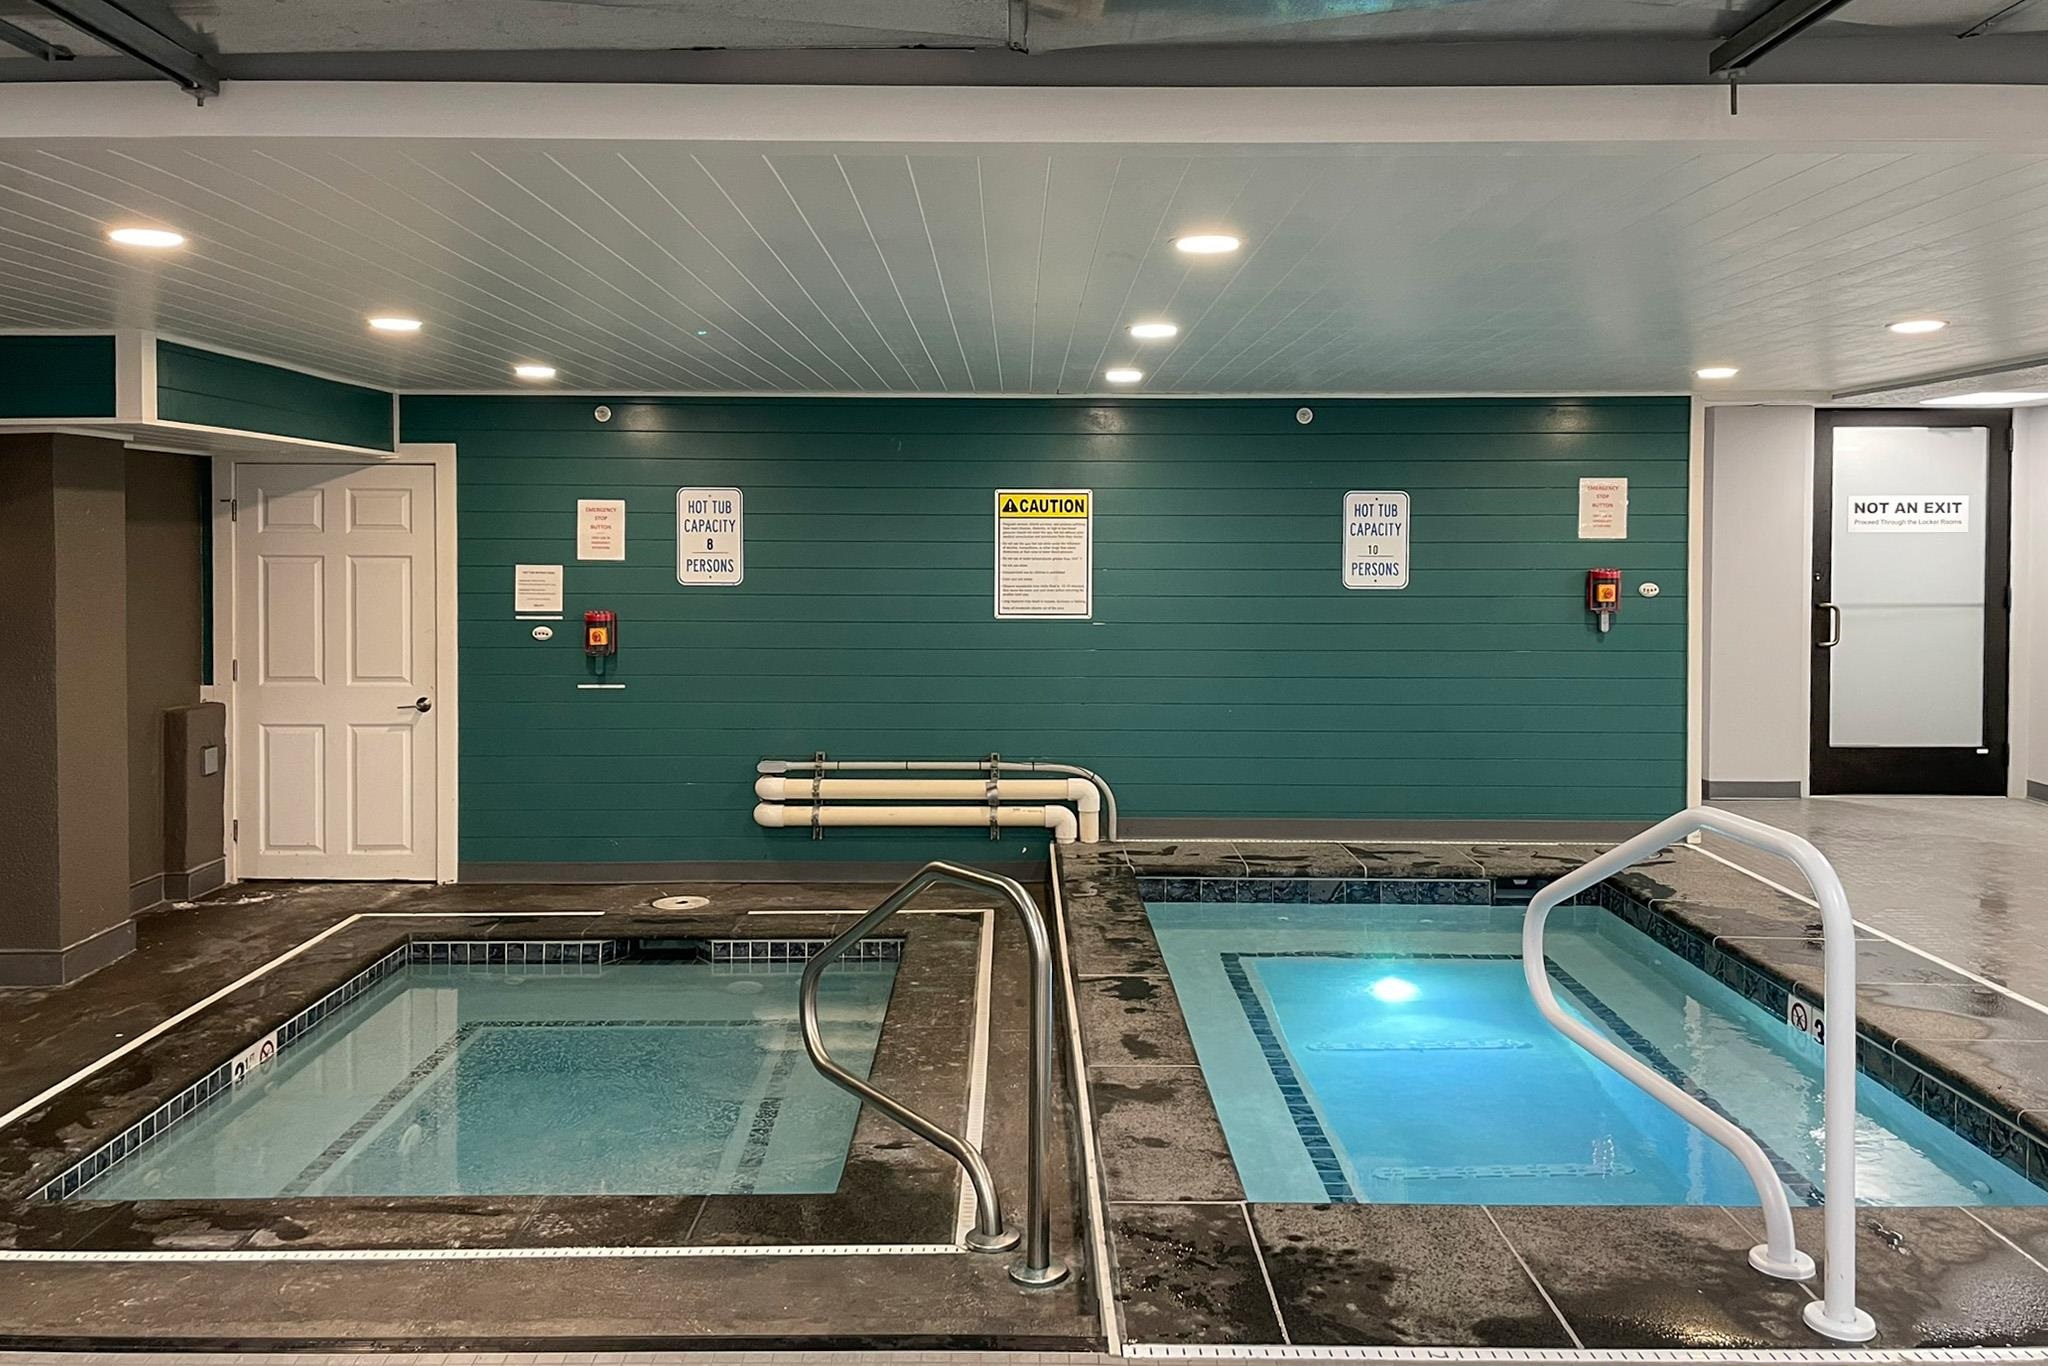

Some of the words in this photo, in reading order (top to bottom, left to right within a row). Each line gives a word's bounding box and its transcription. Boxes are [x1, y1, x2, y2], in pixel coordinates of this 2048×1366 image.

[688, 500, 707, 514] HOT
[712, 500, 732, 514] TUB
[1020, 499, 1084, 513] CAUTION
[1354, 503, 1374, 517] HOT
[1378, 503, 1398, 517] TUB
[1854, 502, 1889, 514] NOT
[1894, 502, 1918, 514] AN
[1924, 502, 1962, 514] EXIT
[684, 519, 736, 533] CAPACITY
[1350, 522, 1402, 537] CAPACITY
[1880, 519, 1906, 527] Through
[706, 538, 714, 550] 8
[1368, 544, 1379, 555] 10
[686, 558, 734, 573] PERSONS
[1351, 562, 1400, 576] PERSONS
